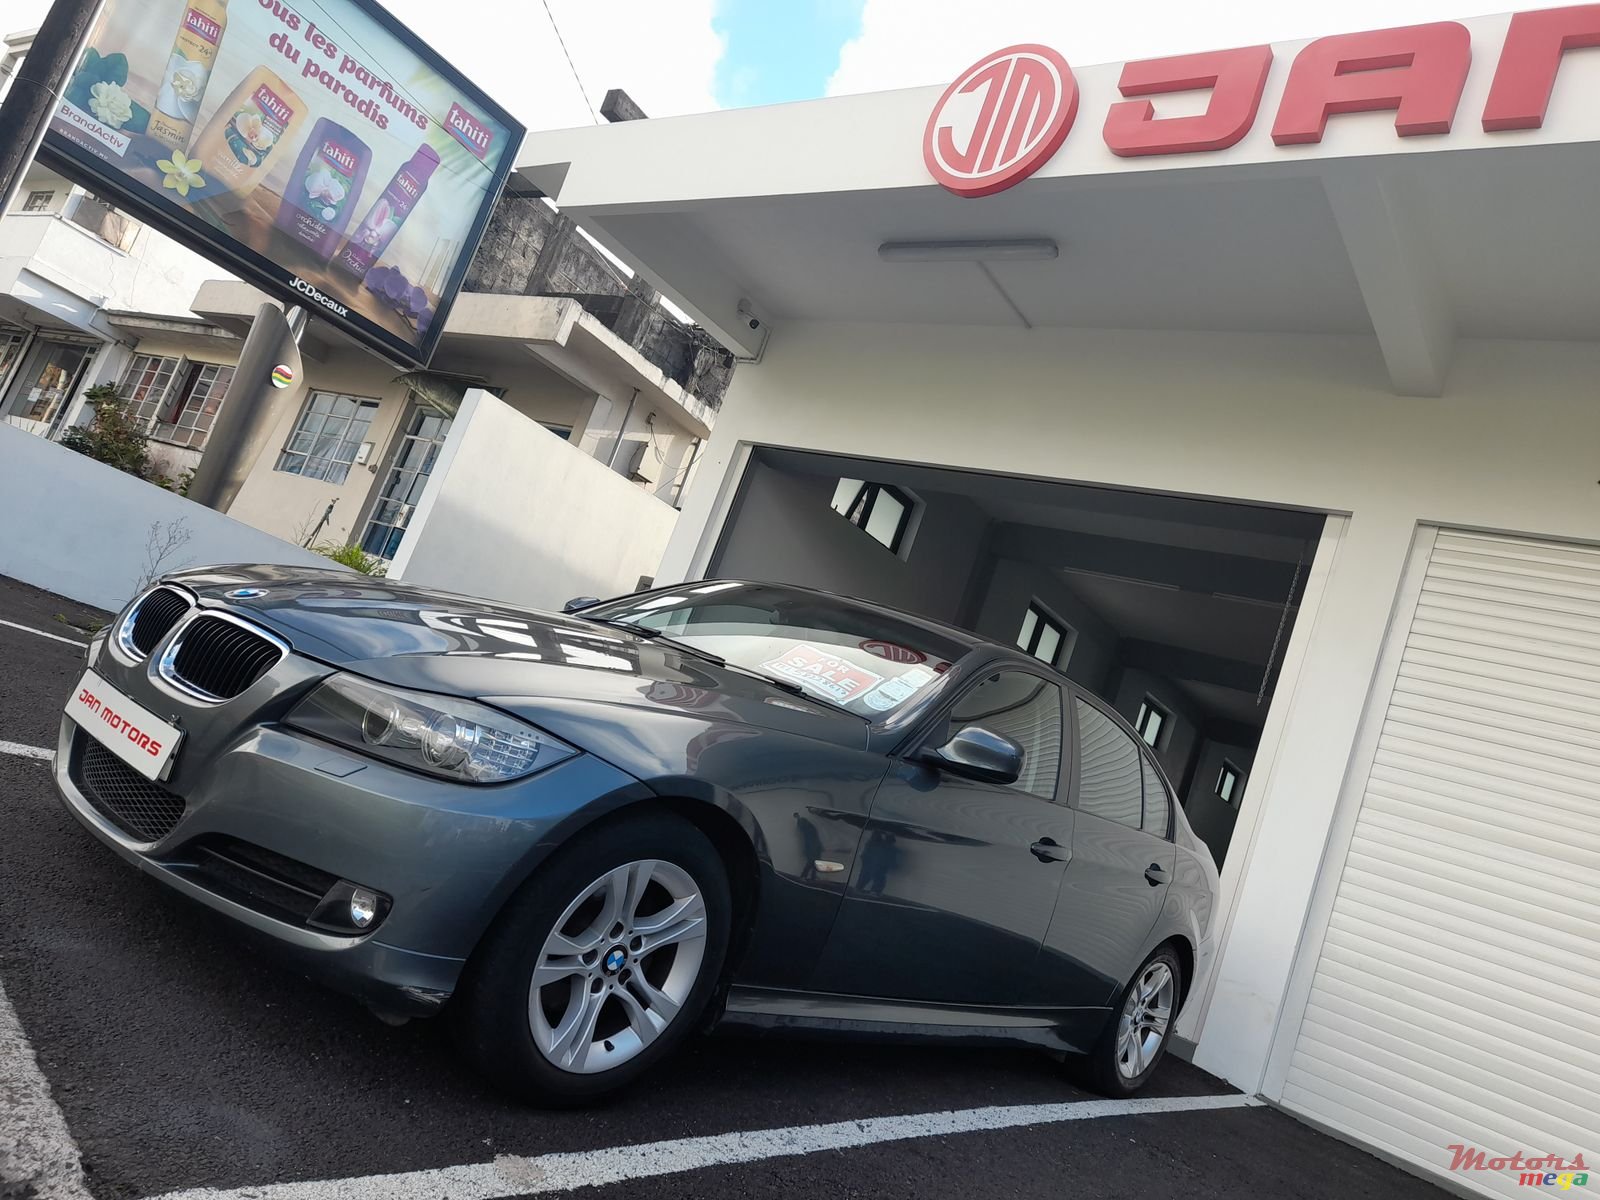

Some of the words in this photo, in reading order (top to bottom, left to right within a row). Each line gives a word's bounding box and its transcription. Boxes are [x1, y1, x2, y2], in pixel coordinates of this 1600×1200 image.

[187, 12, 218, 38] tahiti
[269, 33, 301, 64] du
[302, 58, 389, 130] paradis
[304, 22, 338, 59] les
[339, 54, 428, 130] parfums
[258, 88, 290, 120] tahiti
[60, 104, 124, 148] BrandActiv
[151, 120, 184, 143] Jasmin
[450, 109, 489, 148] tahiti
[323, 141, 355, 169] tahiti
[289, 277, 348, 317] JCDecaux
[788, 656, 860, 692] SALE
[79, 688, 102, 713] JAN
[100, 706, 162, 757] MOTORS
